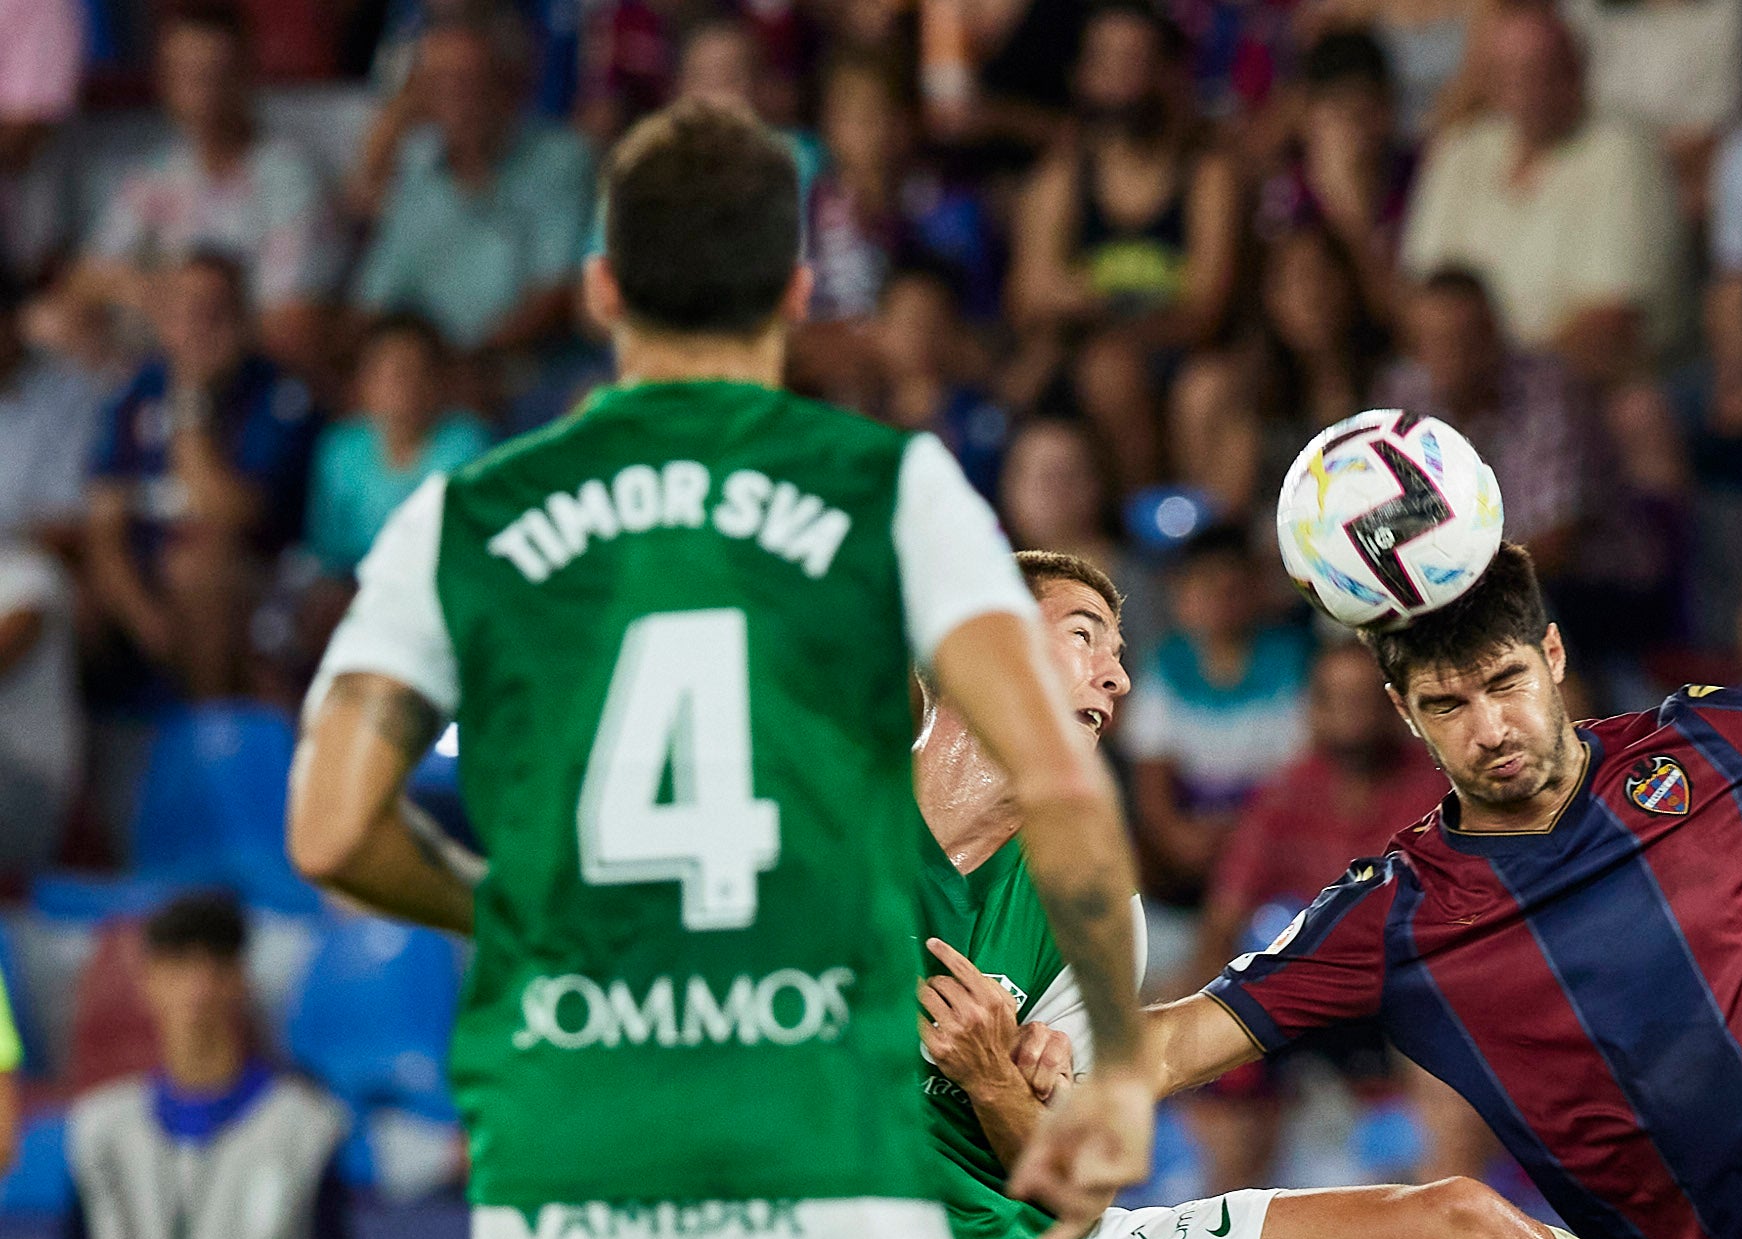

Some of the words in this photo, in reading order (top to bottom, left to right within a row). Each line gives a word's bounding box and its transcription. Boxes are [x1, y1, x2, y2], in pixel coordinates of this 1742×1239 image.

[486, 459, 711, 584] TIMOR
[712, 468, 853, 580] SVA
[576, 606, 782, 931] 4
[512, 966, 856, 1050] SOMMOS
